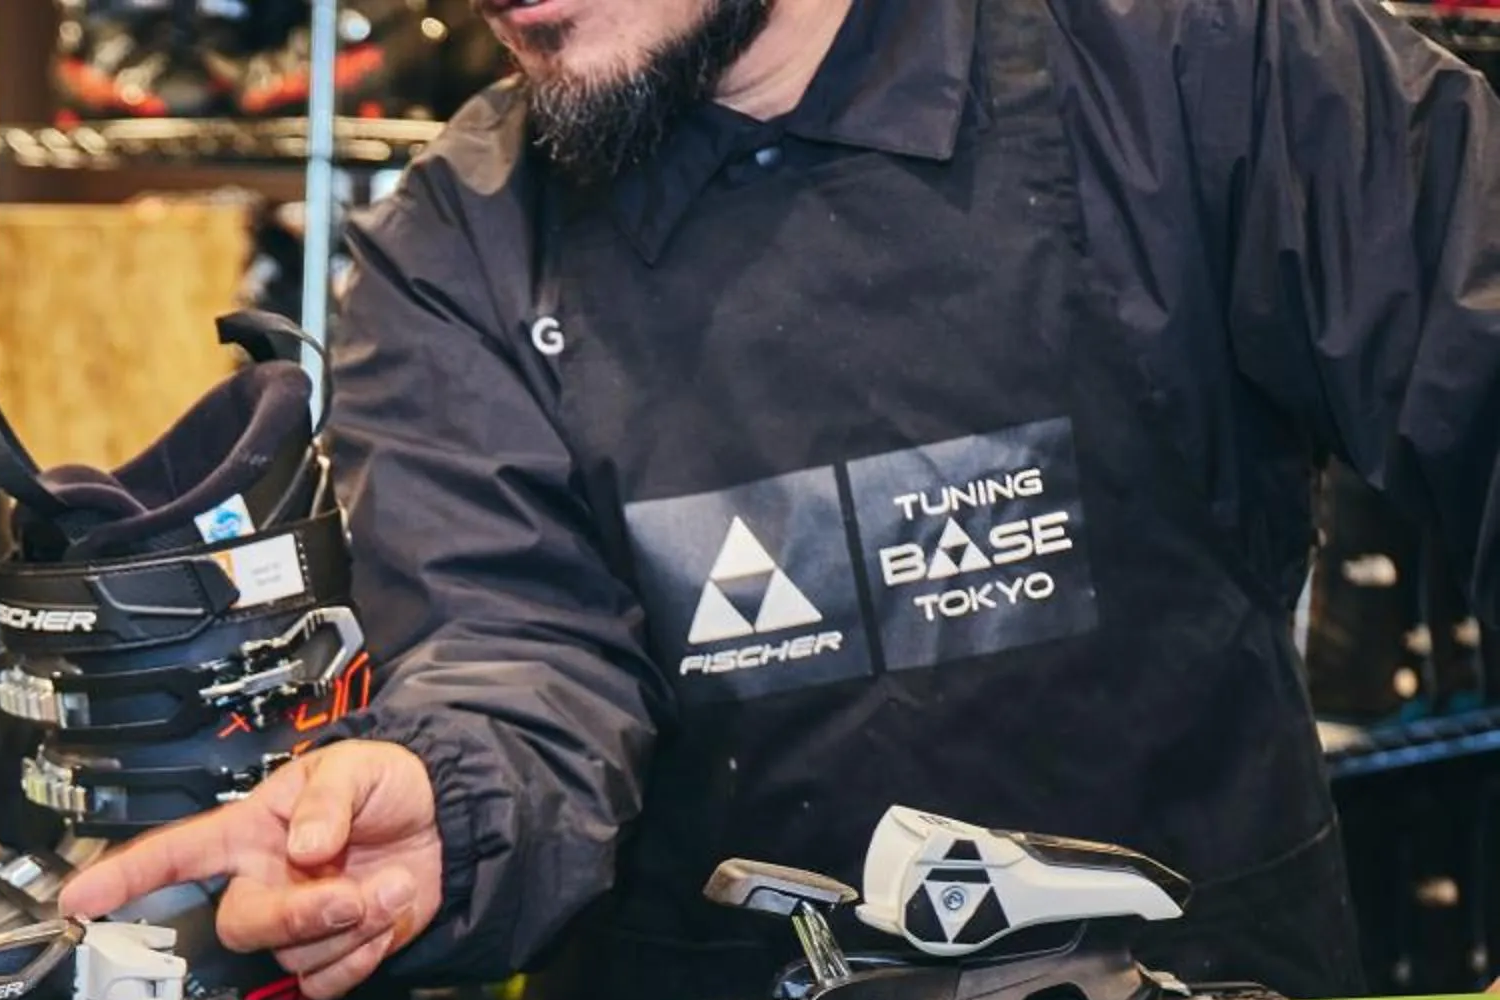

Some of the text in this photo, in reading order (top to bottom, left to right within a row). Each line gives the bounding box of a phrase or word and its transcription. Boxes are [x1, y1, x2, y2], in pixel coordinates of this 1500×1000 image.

[532, 316, 565, 355] G
[893, 467, 1044, 521] TUNING
[913, 571, 1055, 622] TOKYO
[679, 629, 844, 677] FISCHER
